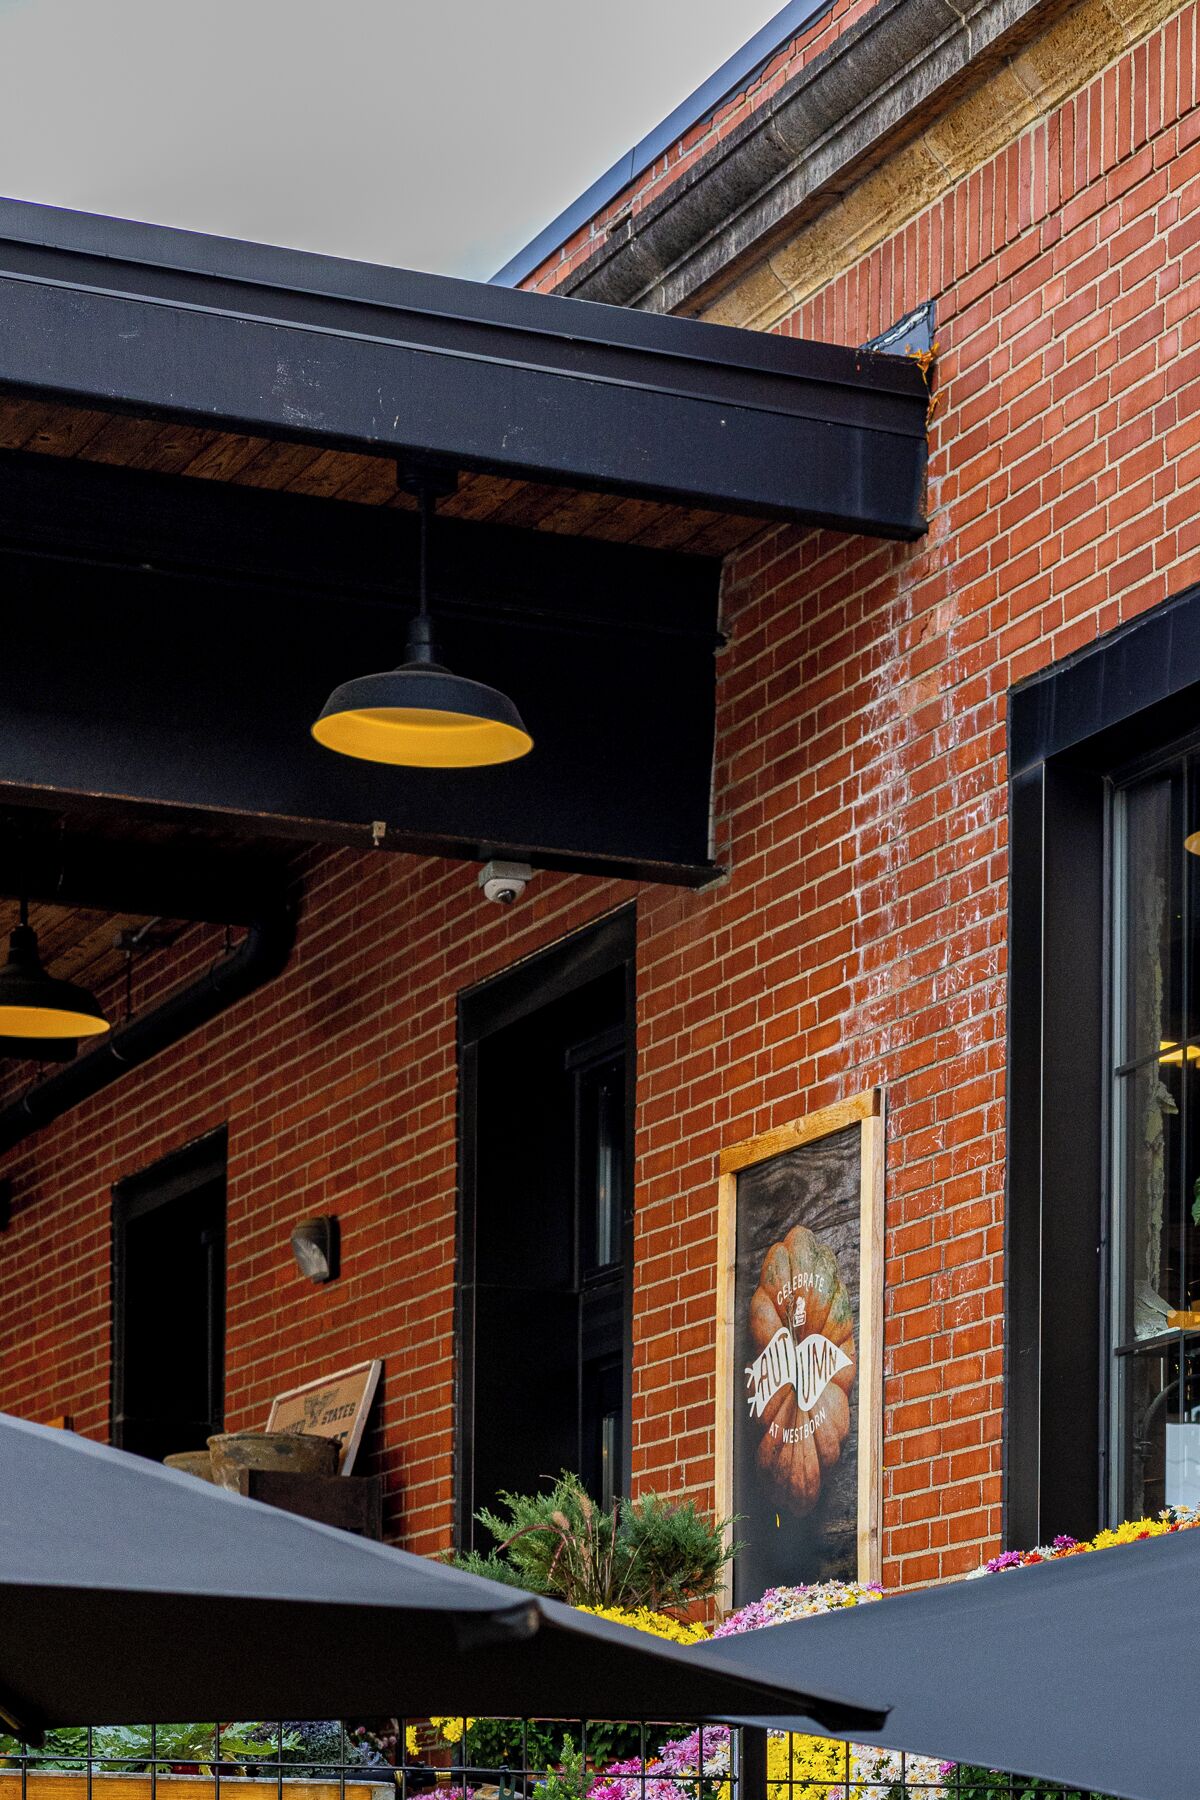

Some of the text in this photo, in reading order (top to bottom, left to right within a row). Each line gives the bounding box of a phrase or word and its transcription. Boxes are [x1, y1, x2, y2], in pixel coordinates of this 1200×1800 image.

[777, 1272, 825, 1305] CELEBRATE
[757, 1333, 837, 1403] AUTUMN
[321, 1402, 356, 1425] STATES
[769, 1408, 826, 1444] AT WESTBORN
